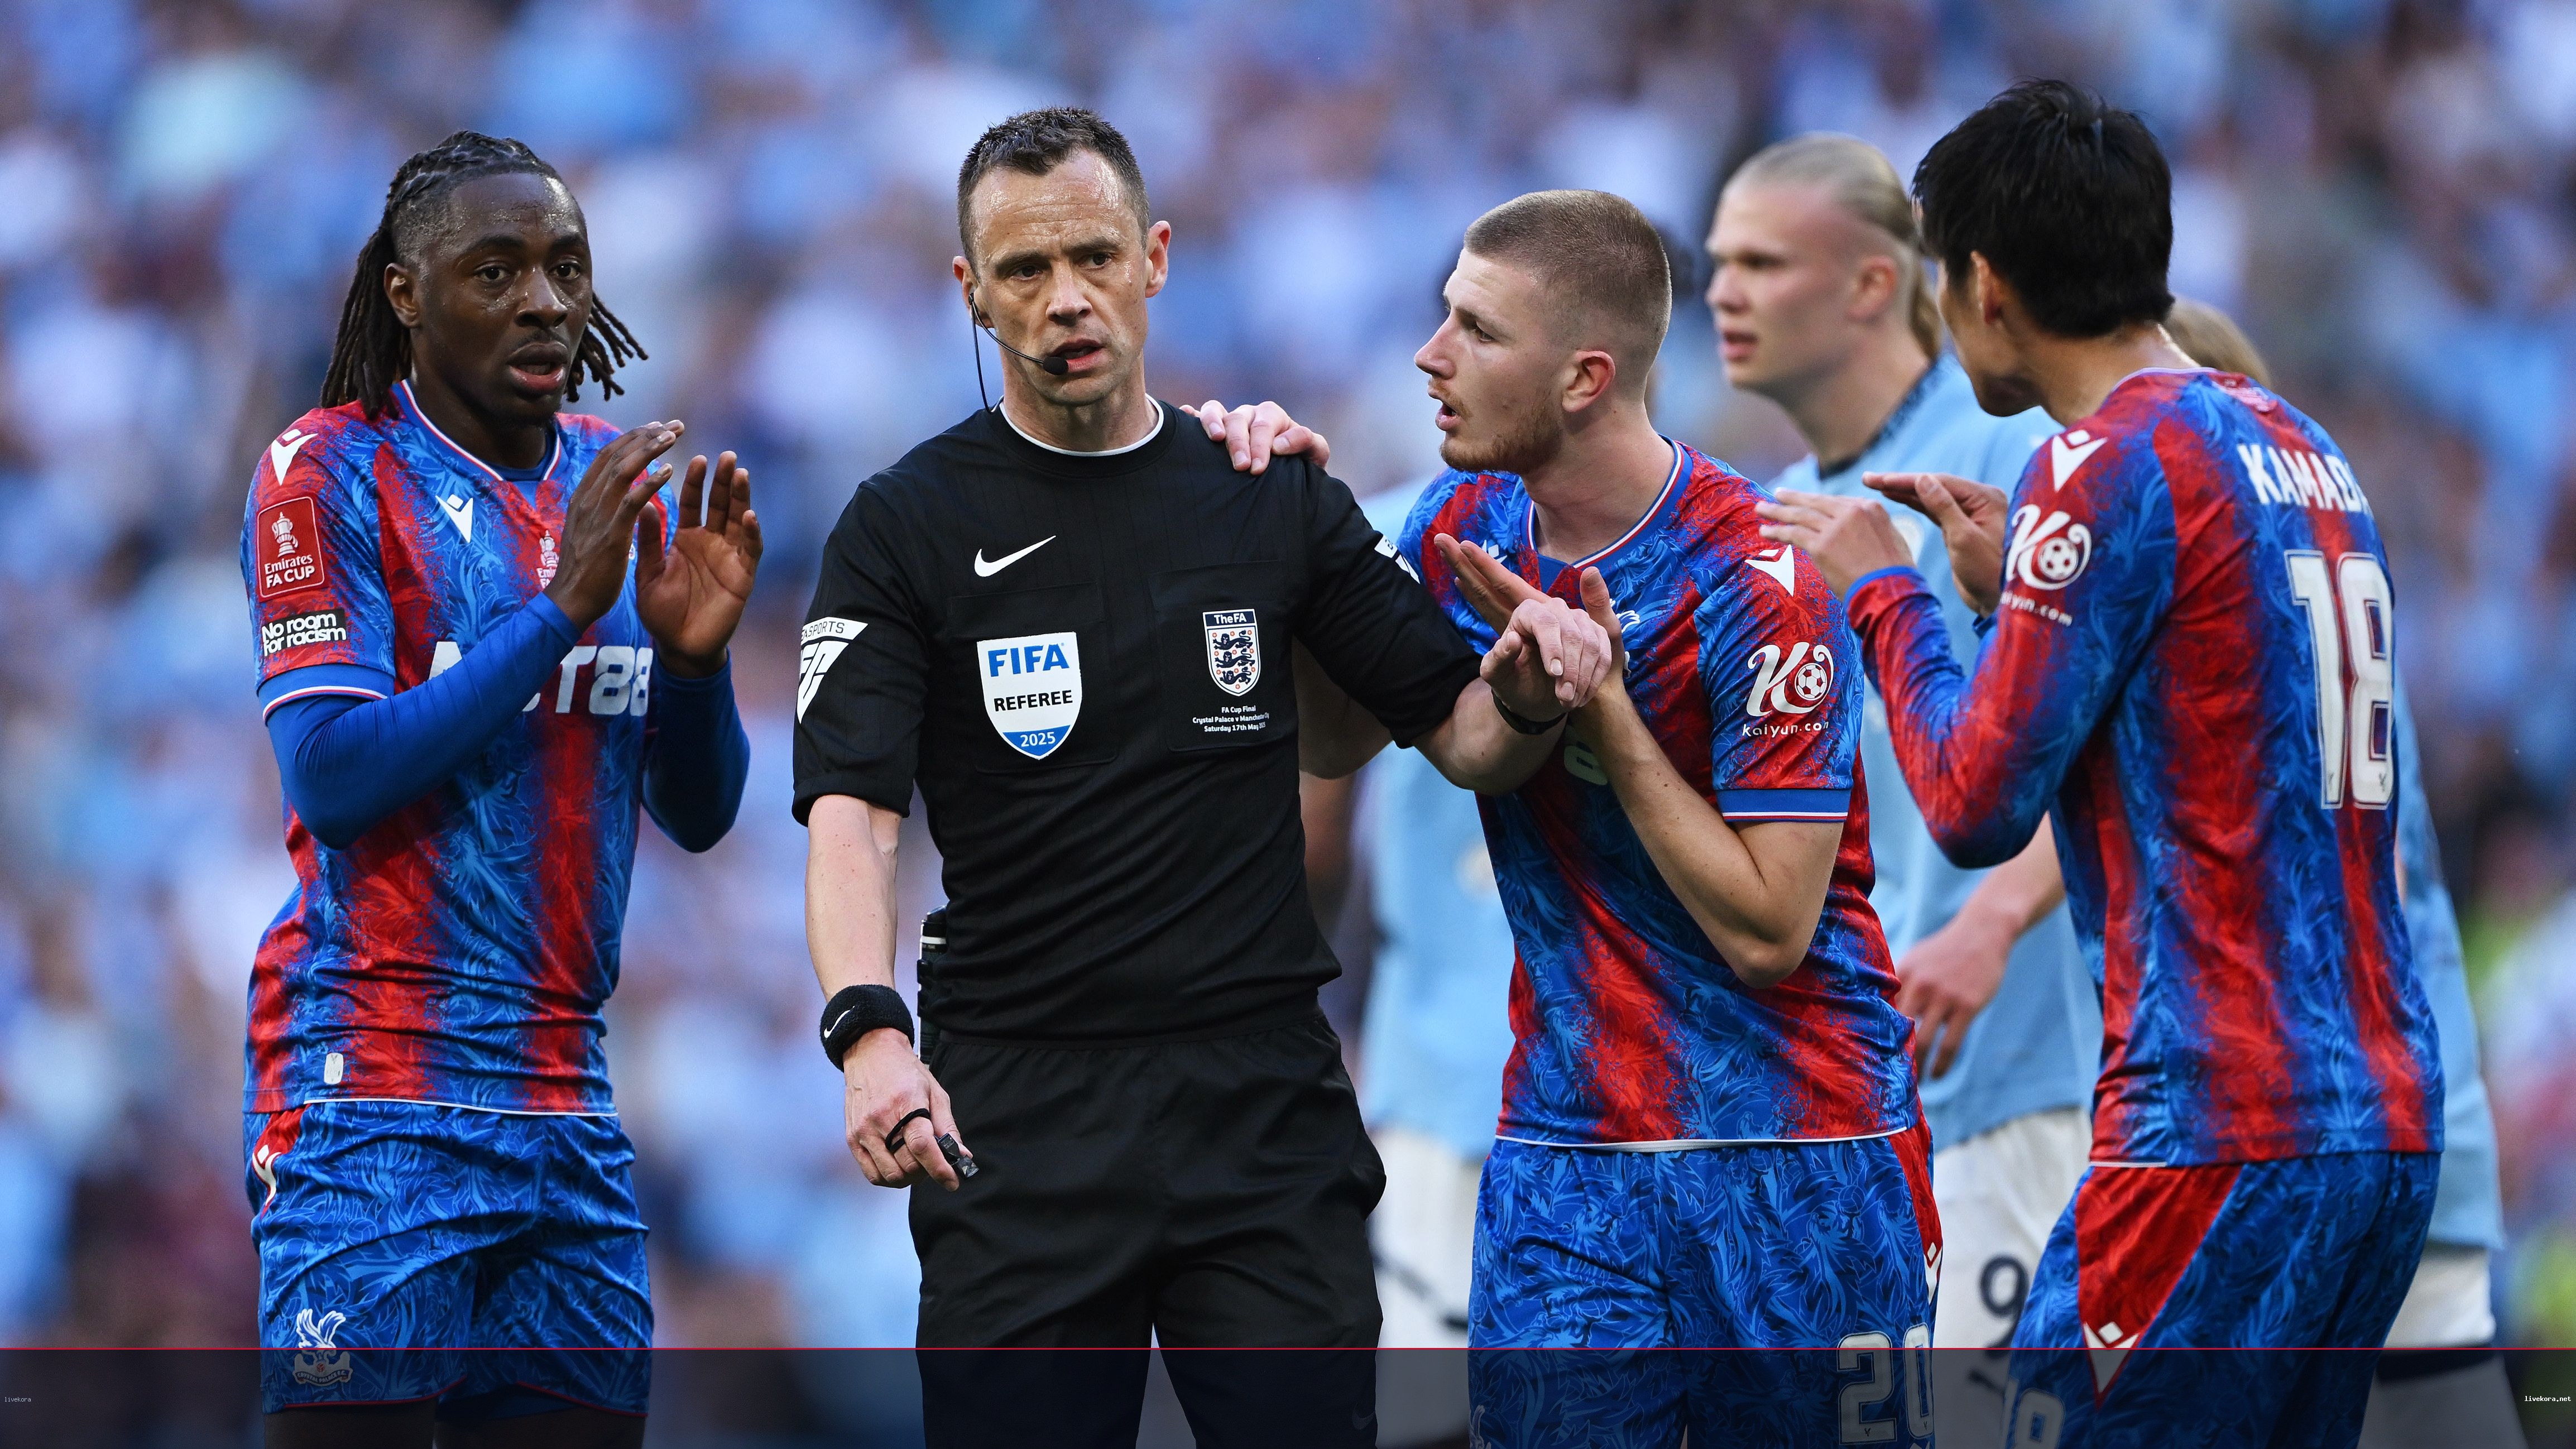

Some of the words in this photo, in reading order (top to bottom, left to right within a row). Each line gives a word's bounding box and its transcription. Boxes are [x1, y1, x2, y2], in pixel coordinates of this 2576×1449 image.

[264, 554, 313, 575] Emirates
[266, 573, 283, 588] FA
[284, 565, 315, 583] CUP
[261, 622, 285, 640] No
[286, 613, 337, 634] room
[809, 621, 845, 637] SPORTS
[263, 637, 285, 656] for
[286, 627, 347, 647] racism
[987, 643, 1069, 678] FIFA
[2284, 549, 2395, 810] 18
[994, 689, 1073, 712] REFEREE
[1192, 716, 1213, 724] Crystal
[1020, 731, 1056, 747] 2025
[1980, 1254, 2029, 1360] 9
[1837, 1322, 1934, 1446] 20
